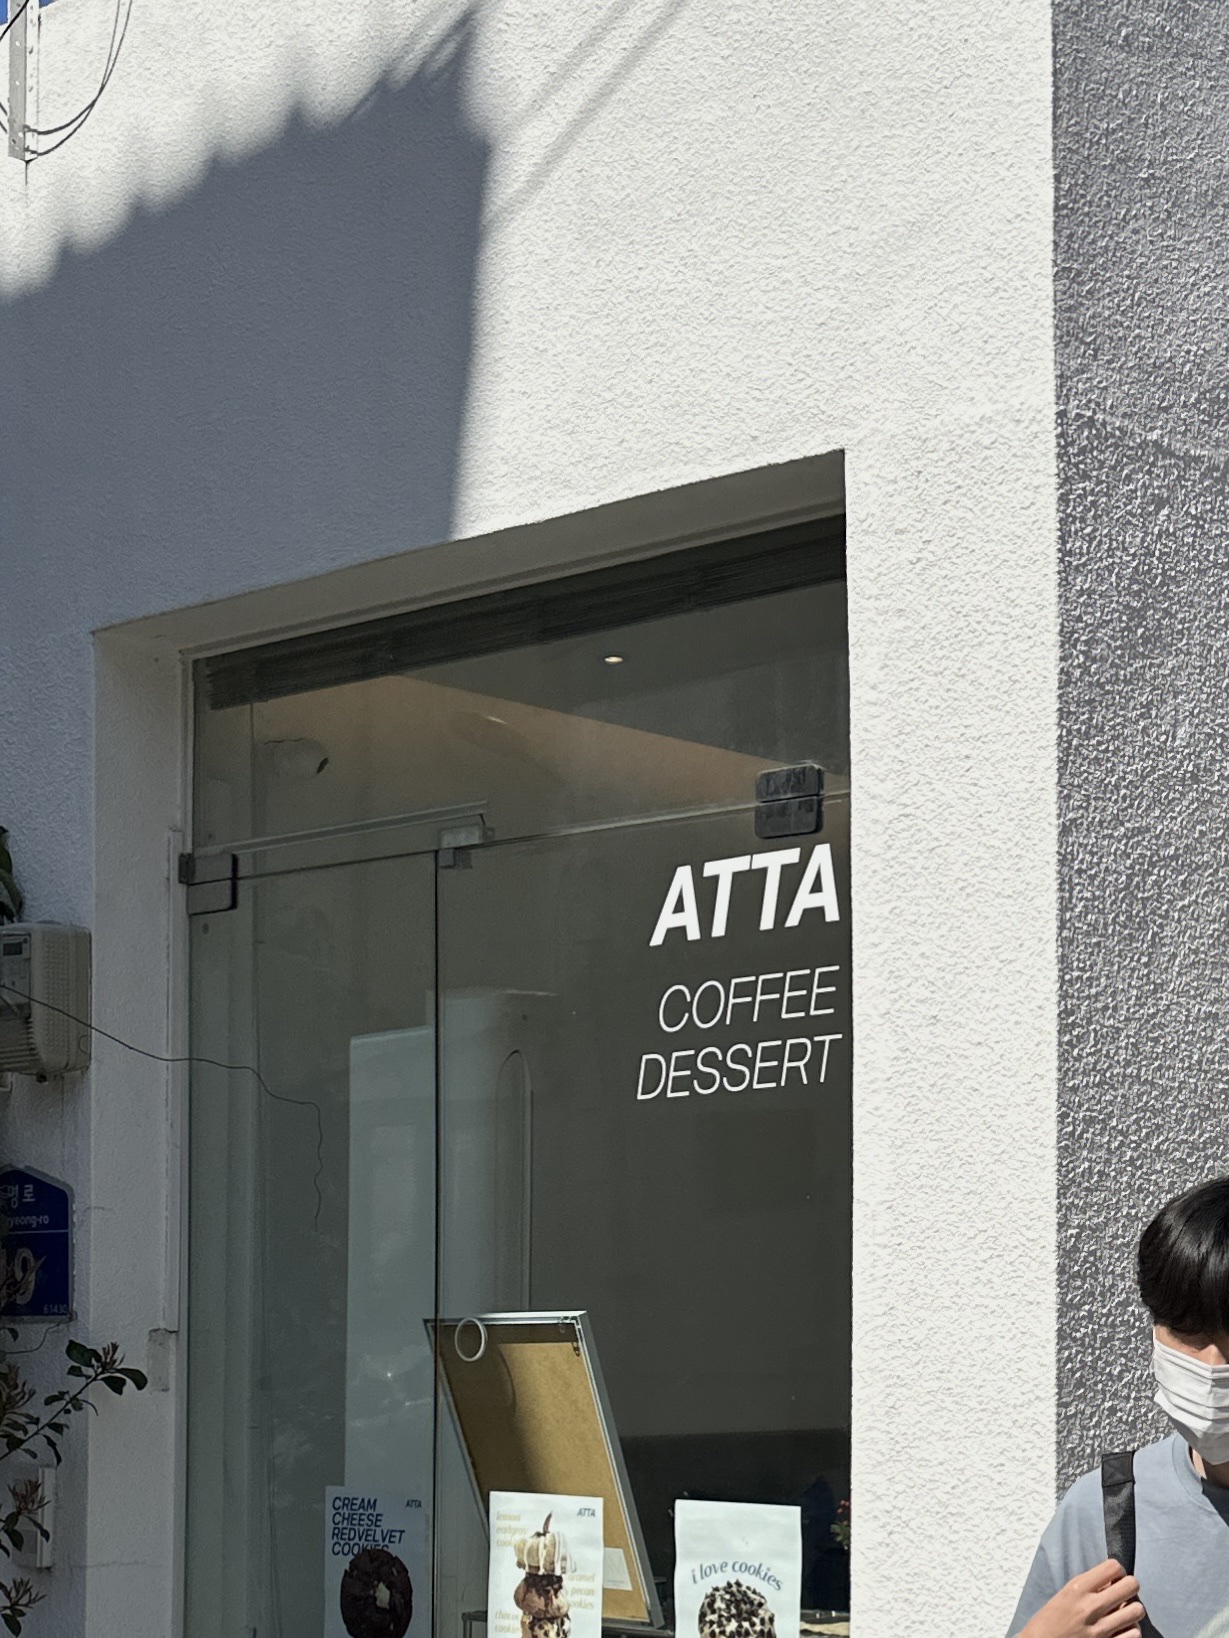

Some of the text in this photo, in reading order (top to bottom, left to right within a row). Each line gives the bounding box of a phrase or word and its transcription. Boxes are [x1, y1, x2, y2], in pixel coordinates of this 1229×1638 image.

[649, 843, 840, 946] ATTA
[659, 965, 840, 1033] COFFEE
[636, 1034, 843, 1100] DESSERT
[332, 1496, 378, 1512] CREAM
[405, 1499, 422, 1508] ATTA
[576, 1507, 596, 1518] ATTA
[332, 1511, 384, 1528] CHEESE
[331, 1526, 406, 1545] REDVELVET
[690, 1560, 784, 1592] i love cookies
